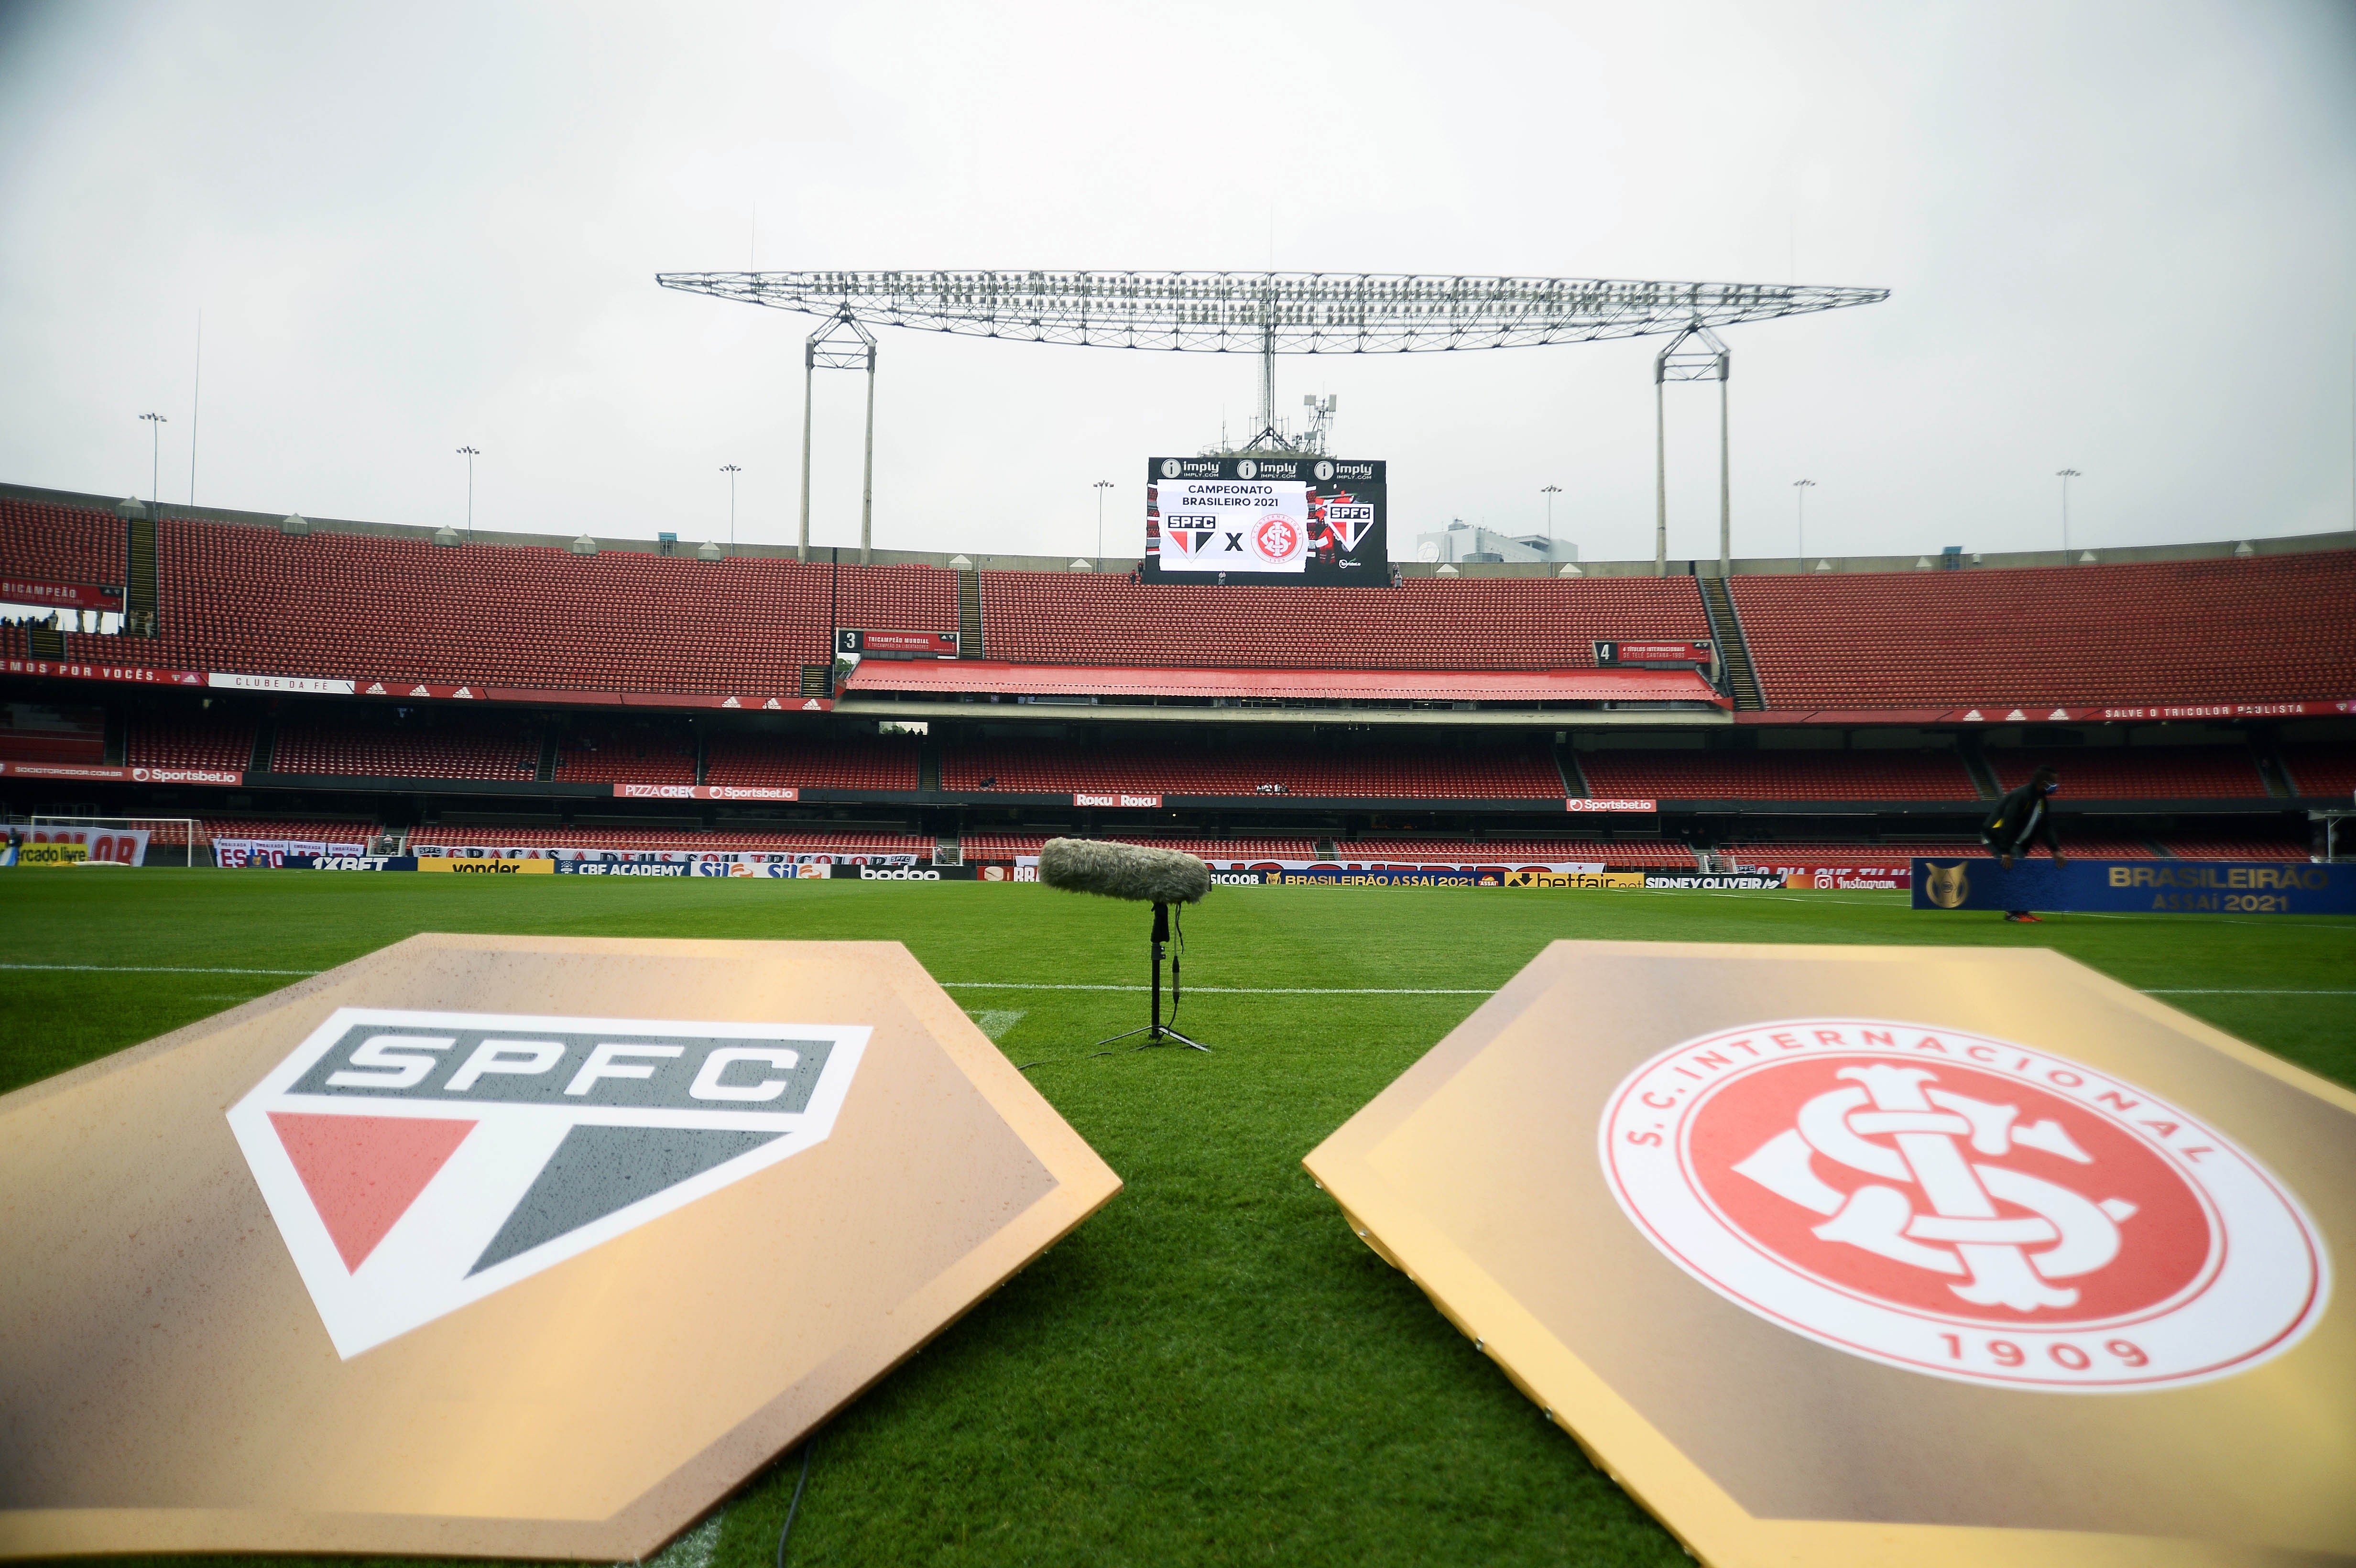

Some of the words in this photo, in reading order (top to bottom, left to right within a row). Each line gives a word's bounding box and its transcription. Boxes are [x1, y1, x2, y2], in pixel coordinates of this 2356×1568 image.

[1183, 461, 1220, 473] imply
[1260, 462, 1296, 474] imply
[1336, 463, 1372, 475] imply
[1189, 485, 1273, 494] CAMPEONATO
[1182, 497, 1251, 506] BRASILEIRO
[1254, 498, 1278, 507] 2021
[1331, 507, 1371, 519] SPFC
[1169, 516, 1214, 528] SPFC
[1224, 532, 1243, 551] X
[2, 583, 76, 598] BICAMPEÃO
[846, 632, 856, 649] 3
[1600, 644, 1610, 660] 4
[59, 665, 91, 676] POR
[103, 667, 160, 681] VOCÊS.
[237, 677, 279, 688] CLUBE
[289, 680, 304, 689] DA
[315, 679, 328, 690] FÉ
[2105, 709, 2142, 718] SALVE
[2150, 708, 2157, 717] O
[2164, 707, 2229, 717] TRICOLOR
[2237, 704, 2302, 715] PAULISTA
[152, 769, 236, 783] Sportsbet.io
[724, 787, 793, 799] Sportsbet.io
[1584, 799, 1651, 811] Sportsbet.io
[452, 860, 520, 873] vonder
[579, 864, 607, 875] CBF
[610, 864, 685, 876] ACADEMY
[1211, 873, 1259, 885] SICOOB
[1285, 873, 1389, 886] BRASILEIRÃO
[1438, 877, 1475, 887] 2021
[1646, 878, 1702, 889] SIDNEY
[1838, 877, 1896, 890] Instagram
[2109, 864, 2328, 890] BRASILEIRÃO
[2224, 894, 2288, 912] 2021
[325, 1034, 799, 1102] SPFC
[1939, 1331, 2151, 1372] 1909
